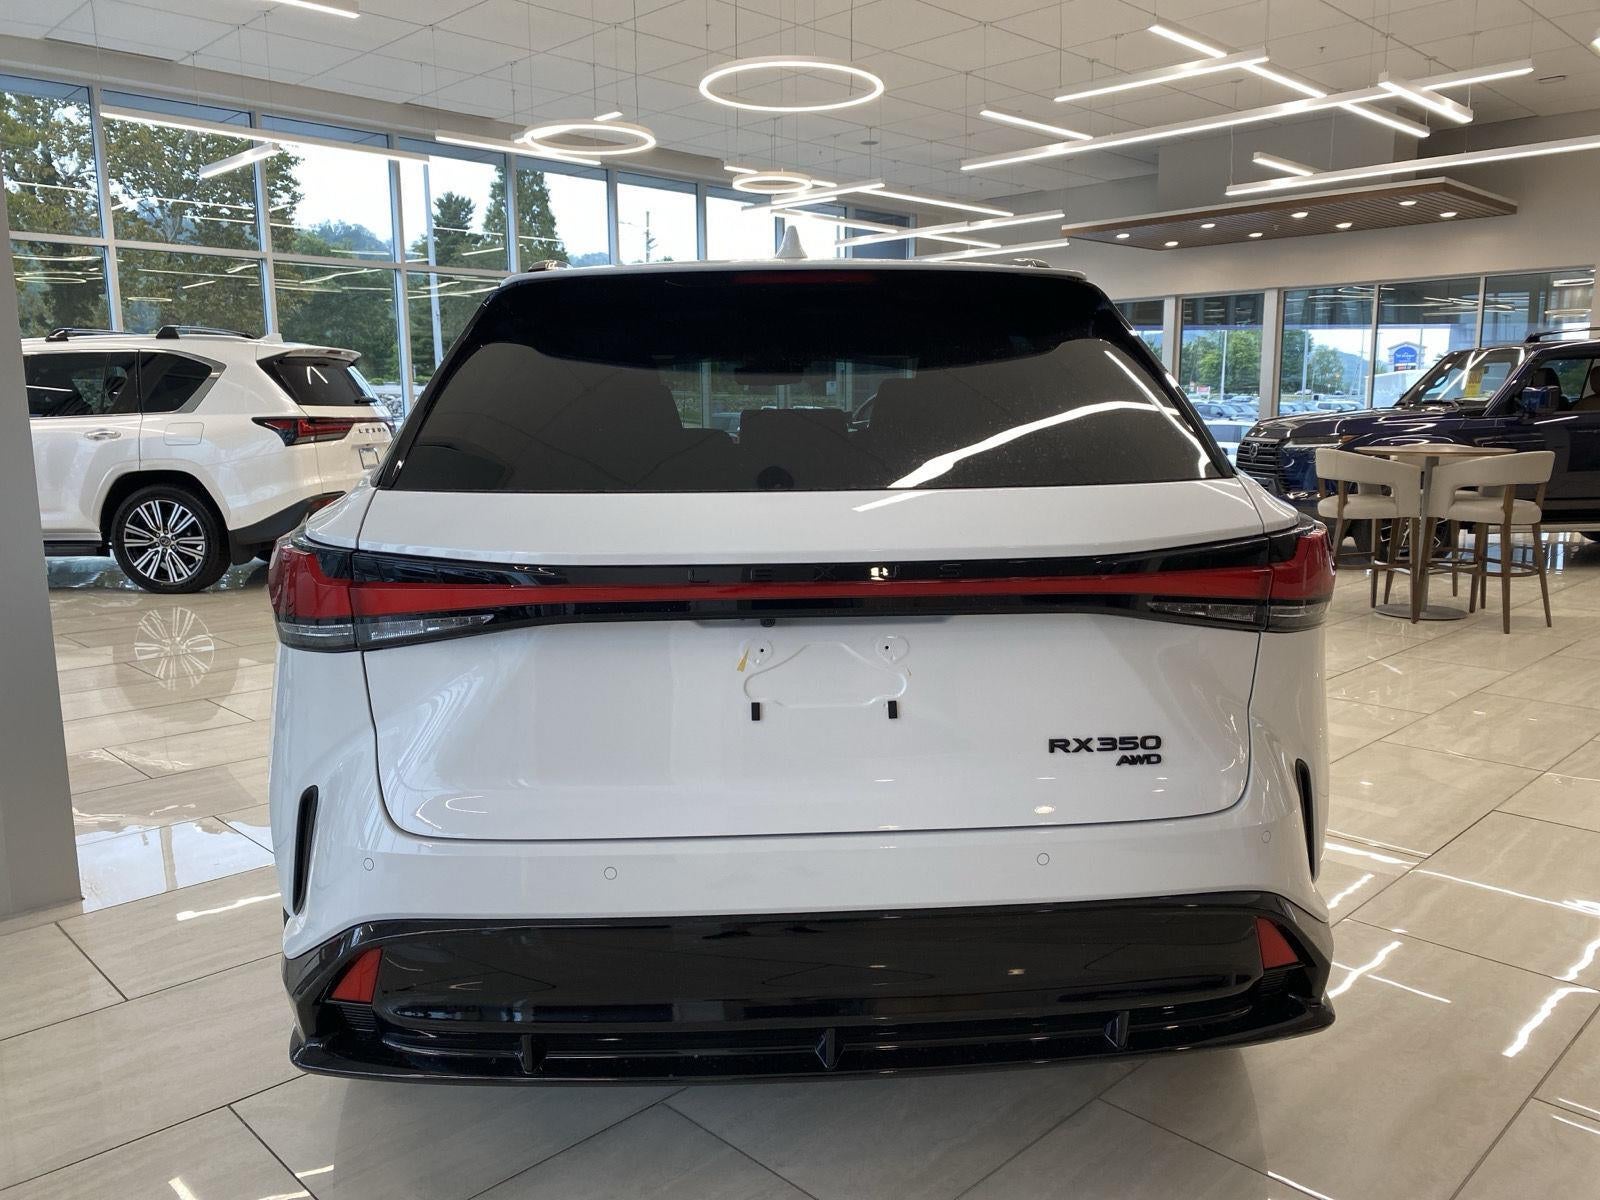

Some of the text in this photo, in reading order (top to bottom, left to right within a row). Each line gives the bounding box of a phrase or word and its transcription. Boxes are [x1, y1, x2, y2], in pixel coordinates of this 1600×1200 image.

[687, 563, 961, 583] LEXUS
[1048, 735, 1162, 753] RX350
[1116, 753, 1162, 766] AWD
